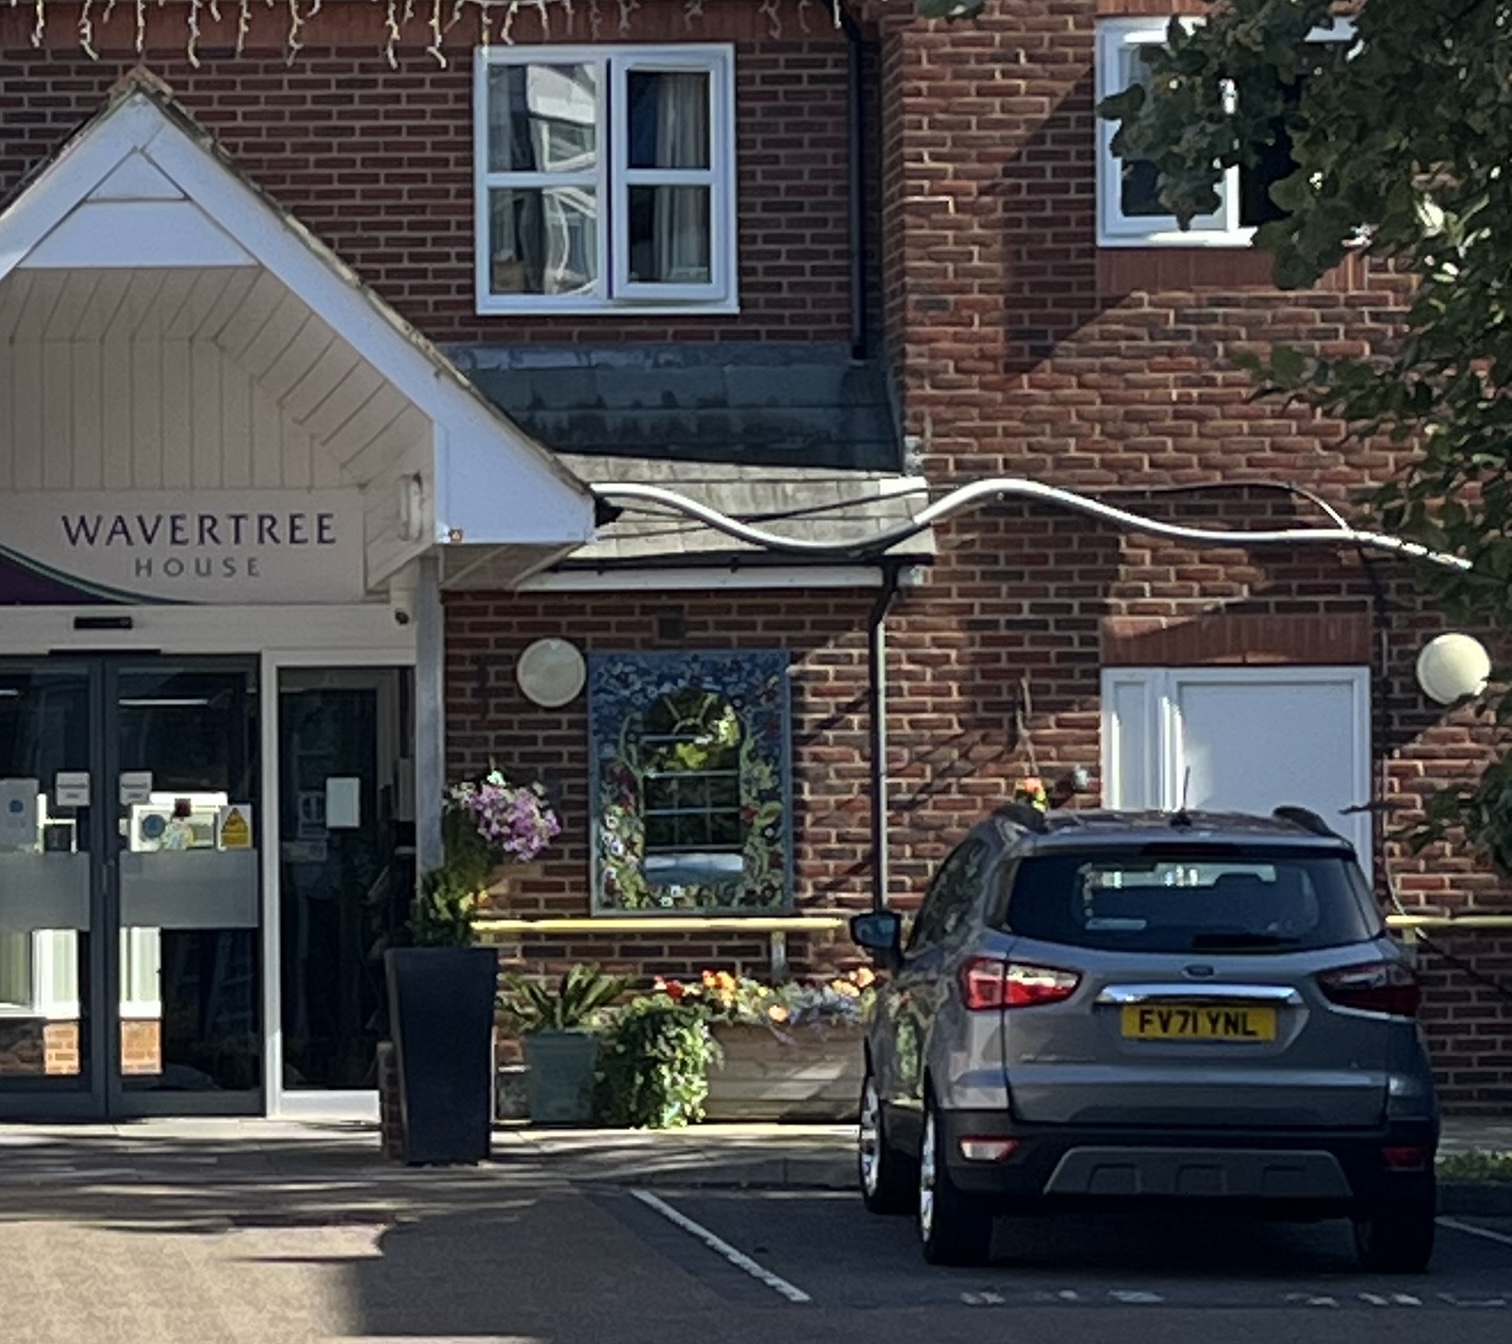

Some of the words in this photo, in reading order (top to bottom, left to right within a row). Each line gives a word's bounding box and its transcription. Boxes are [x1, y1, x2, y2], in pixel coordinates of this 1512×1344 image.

[61, 512, 337, 546] WAVERTREE
[135, 556, 261, 578] HOUSE
[1206, 1011, 1258, 1036] YNL
